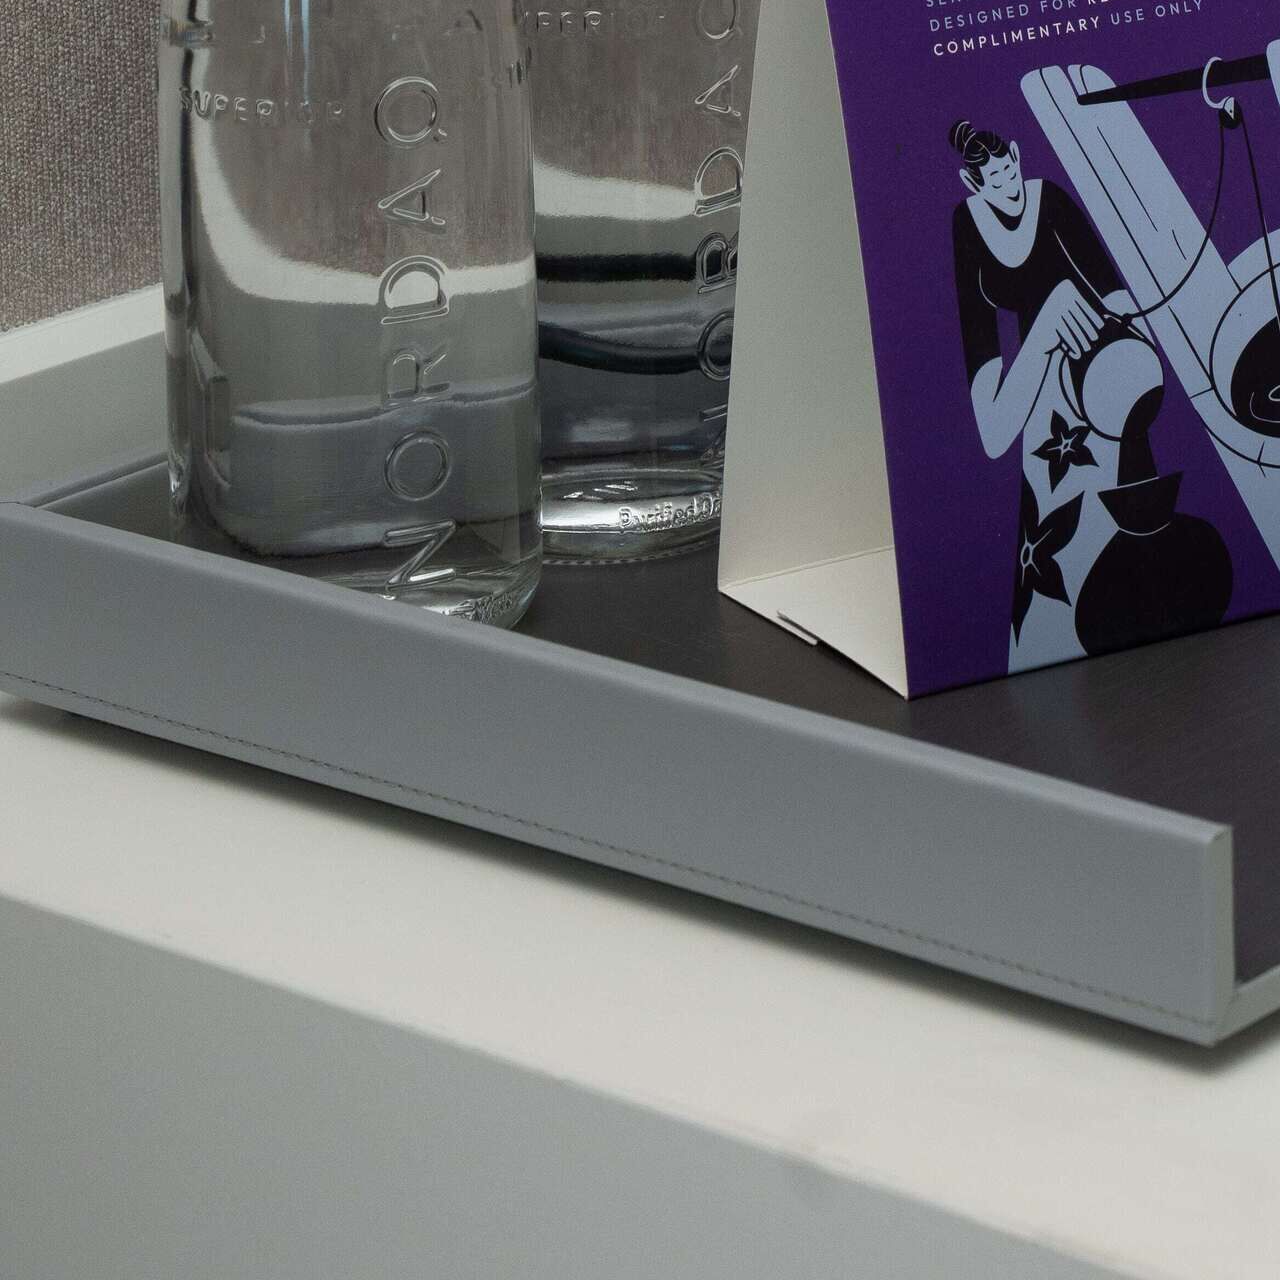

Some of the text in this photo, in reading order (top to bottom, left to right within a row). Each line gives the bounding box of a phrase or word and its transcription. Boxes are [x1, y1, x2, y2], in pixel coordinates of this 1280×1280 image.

[929, 3, 1029, 32] DESIGNED
[933, 15, 1101, 56] COMPLIMENTARY
[1110, 8, 1145, 26] USE
